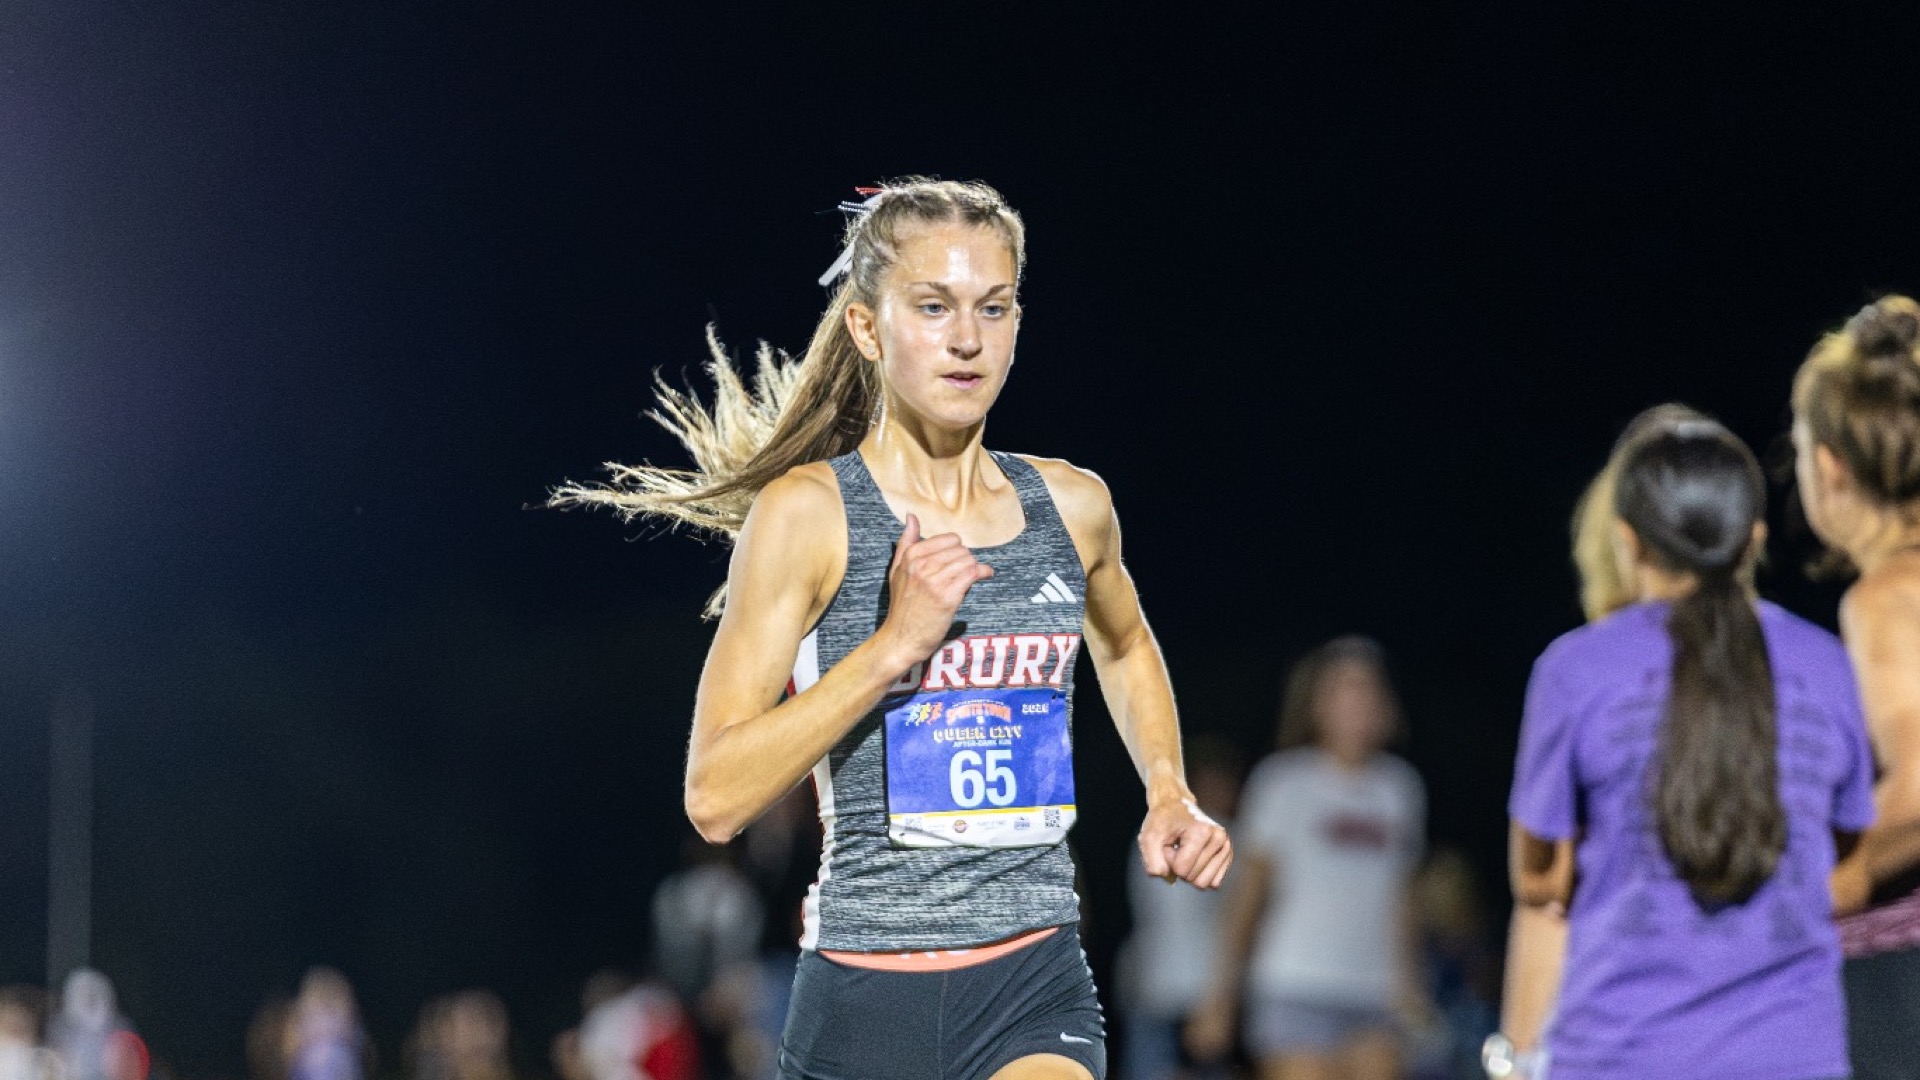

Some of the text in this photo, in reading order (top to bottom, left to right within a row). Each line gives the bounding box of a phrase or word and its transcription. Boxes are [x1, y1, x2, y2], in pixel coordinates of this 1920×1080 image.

[933, 725, 1022, 744] QUEEN CITY
[950, 749, 1017, 808] 65
